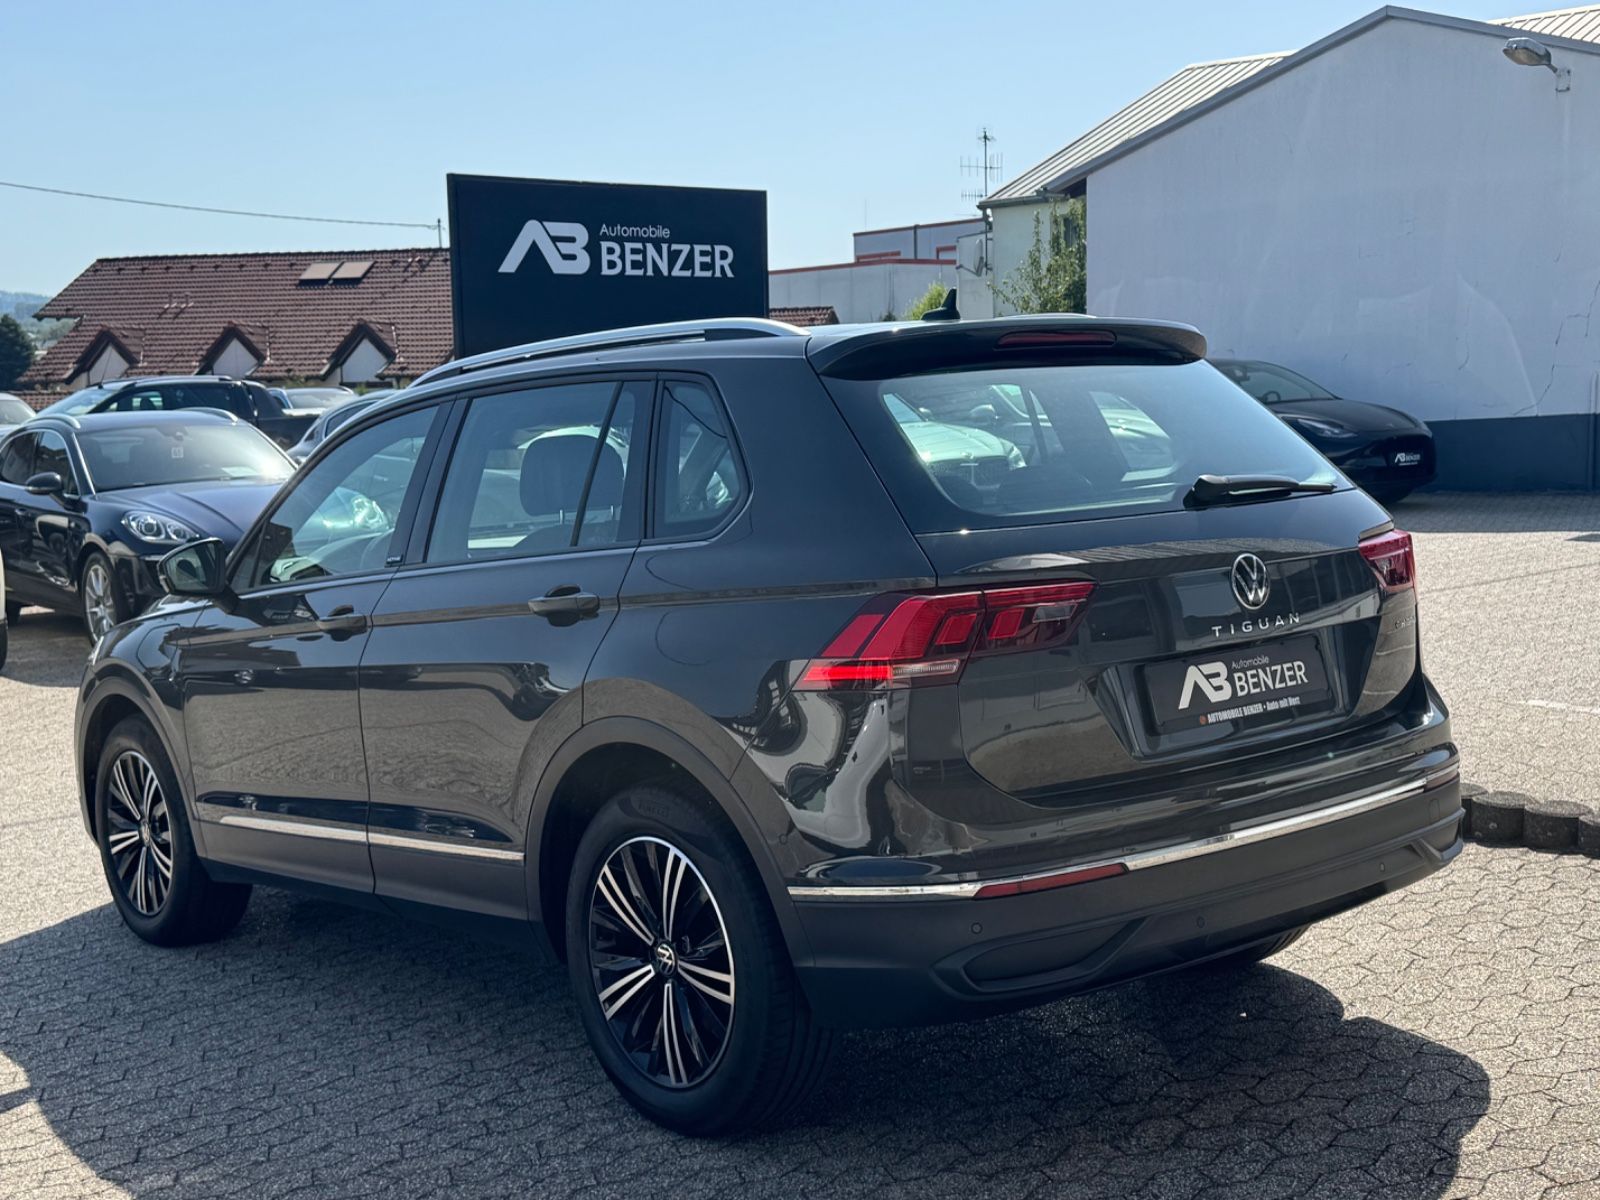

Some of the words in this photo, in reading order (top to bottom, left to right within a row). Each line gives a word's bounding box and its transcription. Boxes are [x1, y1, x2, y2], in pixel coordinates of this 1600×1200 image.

[600, 223, 670, 239] Automobile
[498, 219, 591, 275] AB
[600, 241, 735, 278] BENZER
[1212, 613, 1300, 637] TIGUAN
[1231, 654, 1270, 670] Automobile
[1178, 660, 1233, 710] AB
[1233, 660, 1309, 697] BENZER
[1207, 707, 1244, 724] AUTOMOBILE
[1243, 702, 1264, 717] BENZER
